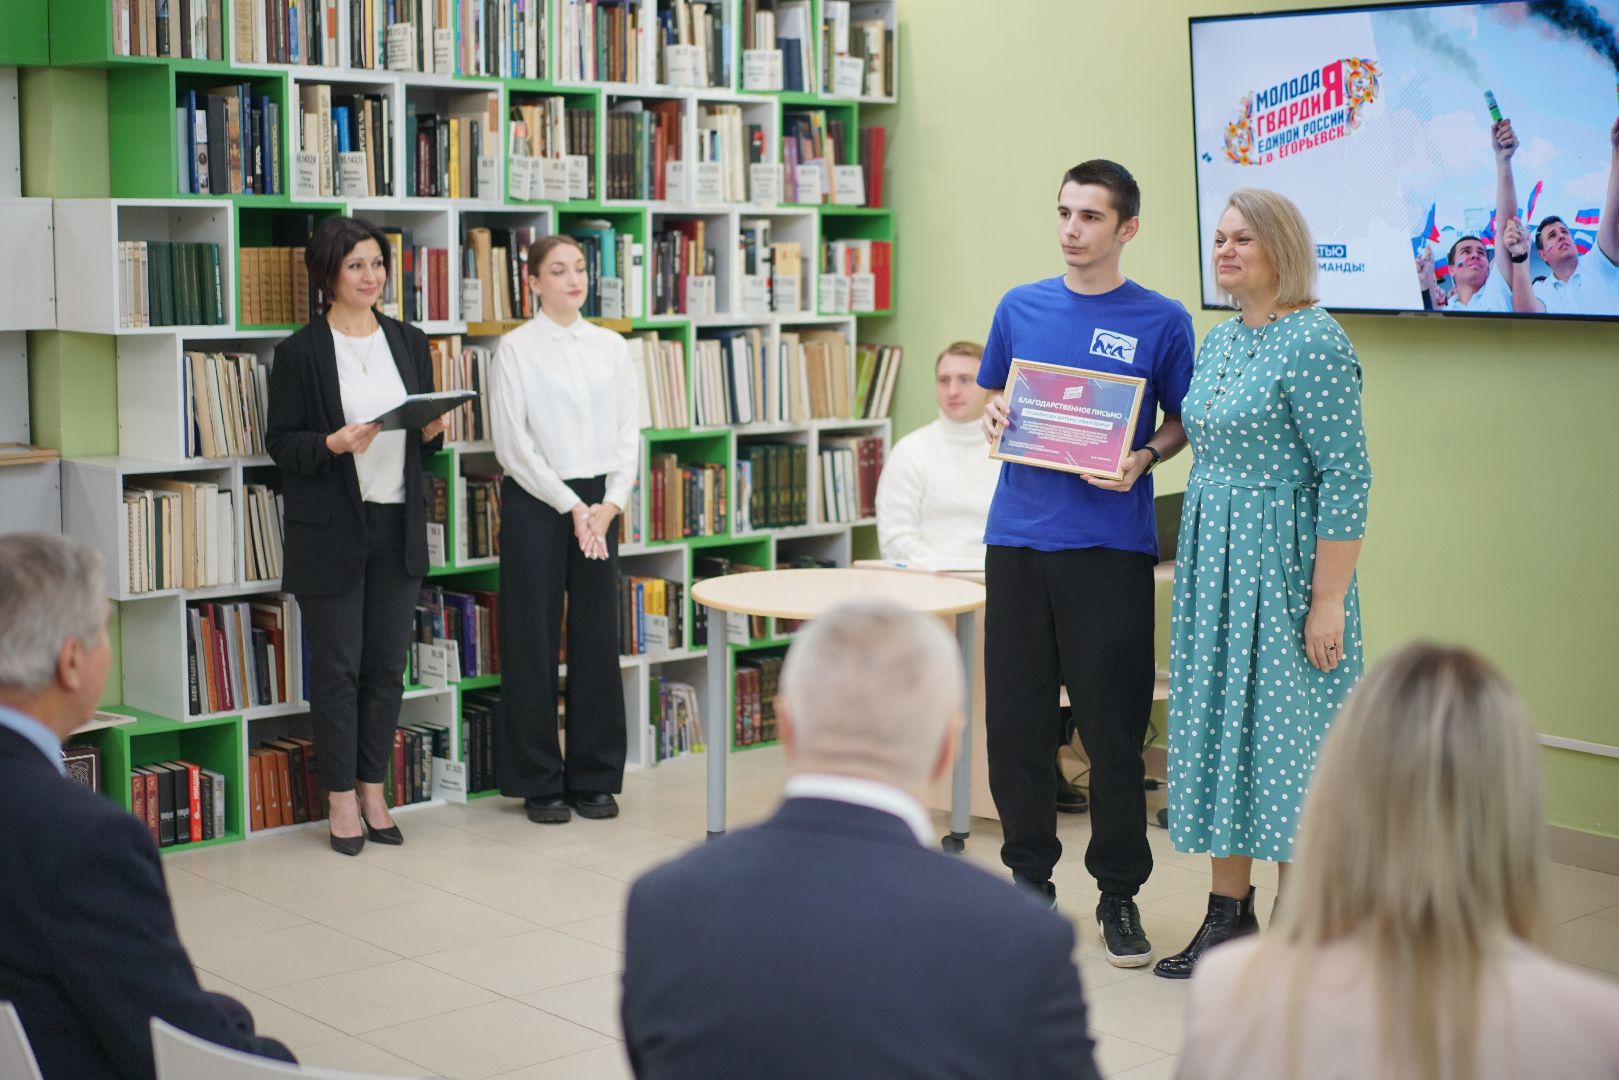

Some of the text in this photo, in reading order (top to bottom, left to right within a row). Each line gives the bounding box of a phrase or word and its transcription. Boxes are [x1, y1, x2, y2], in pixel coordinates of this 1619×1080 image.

[1303, 110, 1344, 138] РОССИИ
[1279, 125, 1344, 158] ЕГОРЬЕВСК
[1318, 262, 1365, 274] МАНДЫ!
[1018, 397, 1123, 420] БЛАГОДАРСТВЕННОЕ ПИСЬМО
